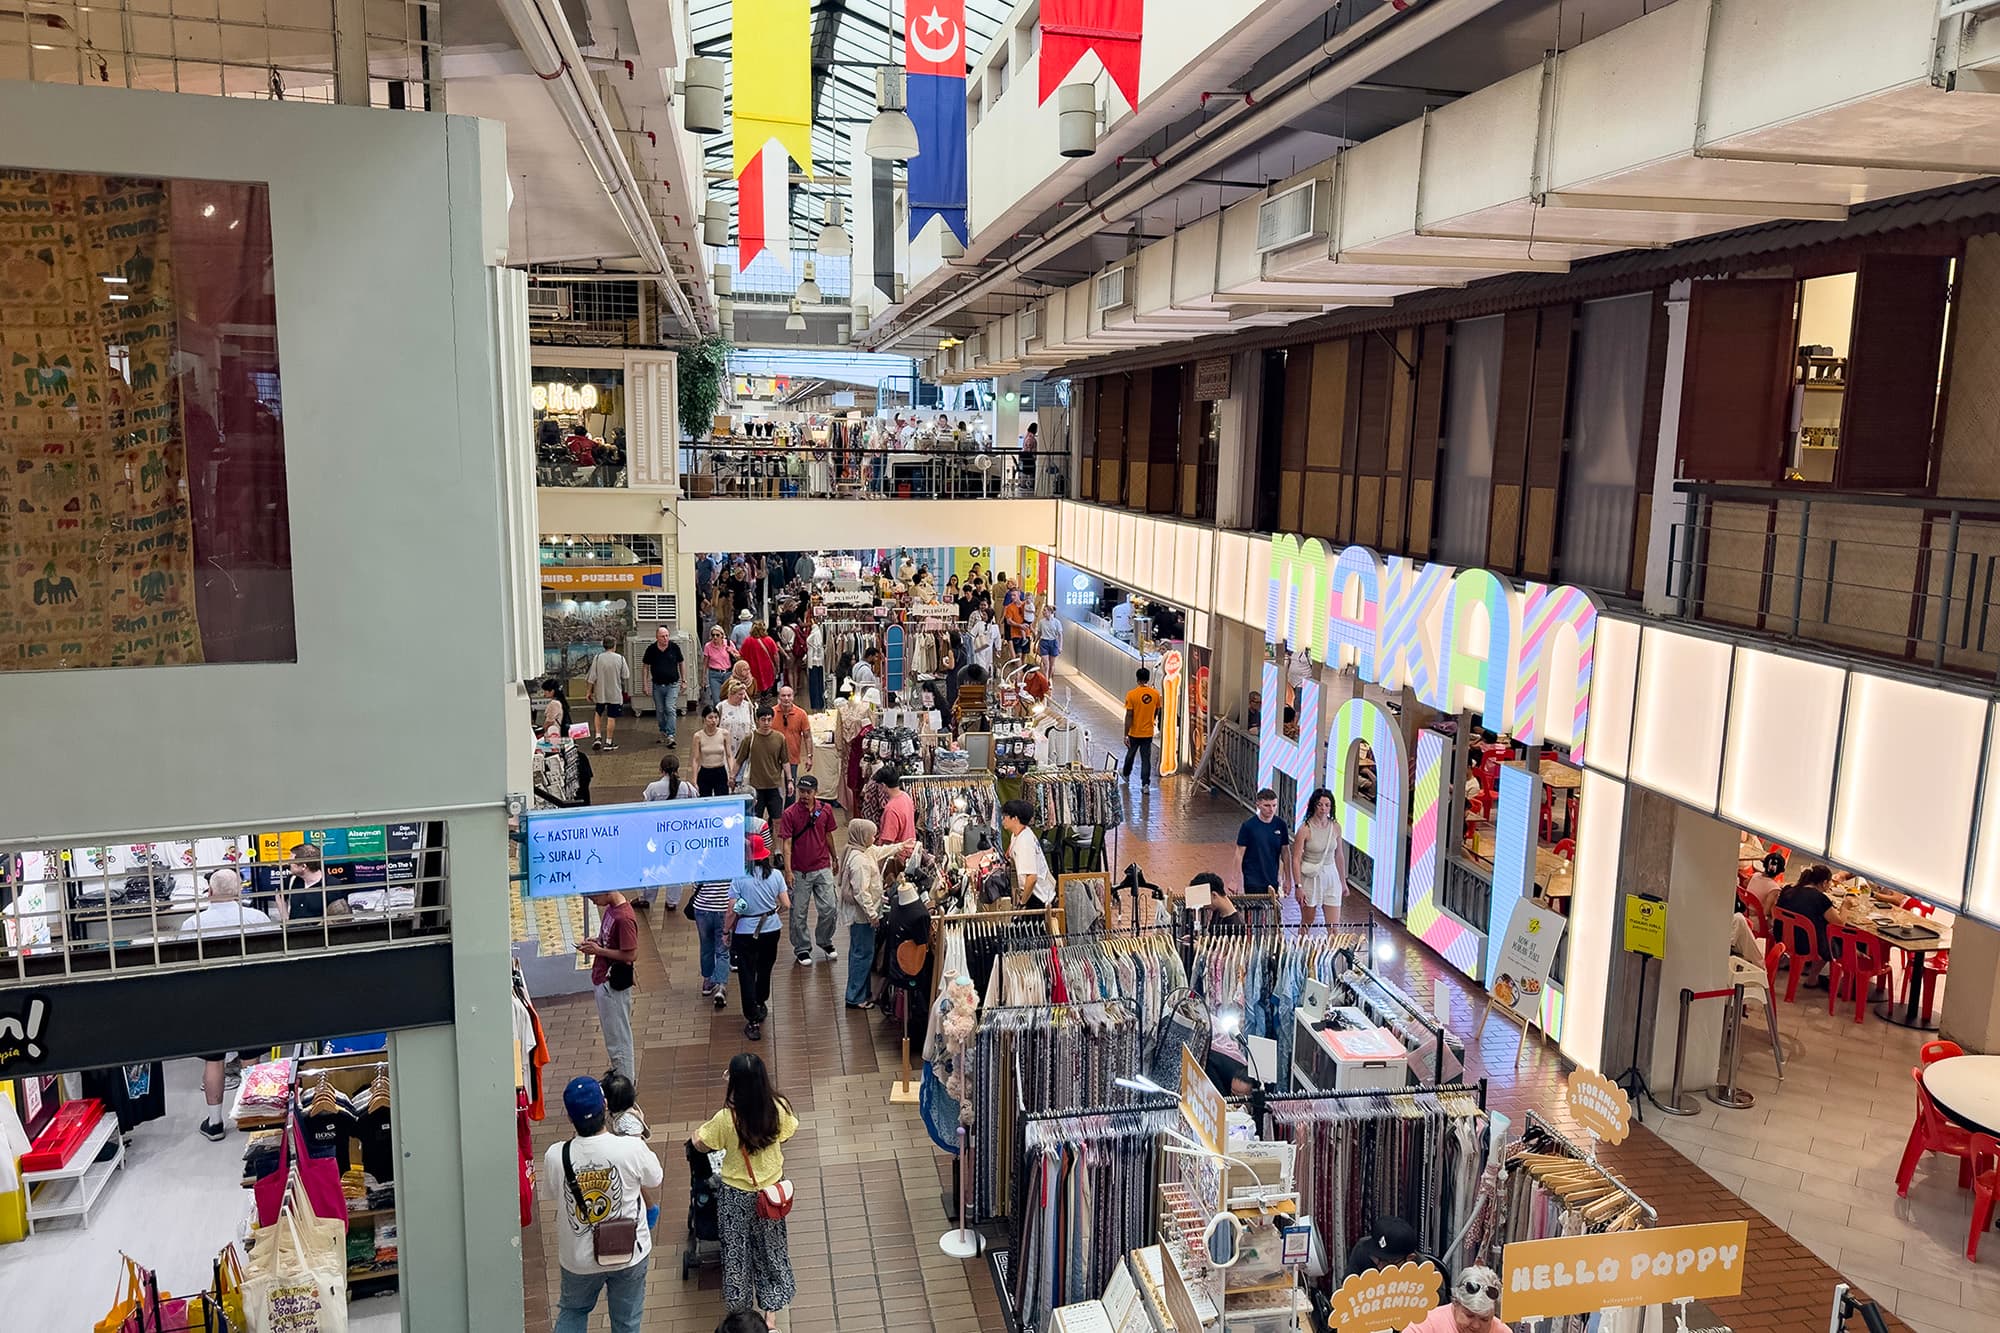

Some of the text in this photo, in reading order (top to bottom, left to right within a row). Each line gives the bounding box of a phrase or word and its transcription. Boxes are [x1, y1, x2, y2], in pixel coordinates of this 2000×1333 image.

[581, 573, 635, 583] PUZZLES
[1266, 533, 1603, 768] MAKAN
[547, 825, 620, 842] KASTURI WALK
[656, 815, 738, 833] INFORMATIO
[548, 849, 582, 864] SURAU
[684, 836, 730, 851] COUNTER
[1258, 661, 1564, 1045] HALL
[549, 872, 572, 885] ATM
[1581, 1082, 1598, 1098] FOR
[1598, 1088, 1621, 1116] RM59
[1571, 1094, 1577, 1104] 2
[1578, 1094, 1594, 1110] FOR
[1594, 1101, 1622, 1132] RM100
[1511, 1244, 1739, 1293] HELLO POPPY
[1349, 1281, 1425, 1308] 1 FOR RM59
[1340, 1312, 1350, 1324] 2
[1352, 1299, 1381, 1318] FOR
[1382, 1295, 1429, 1310] RM100
